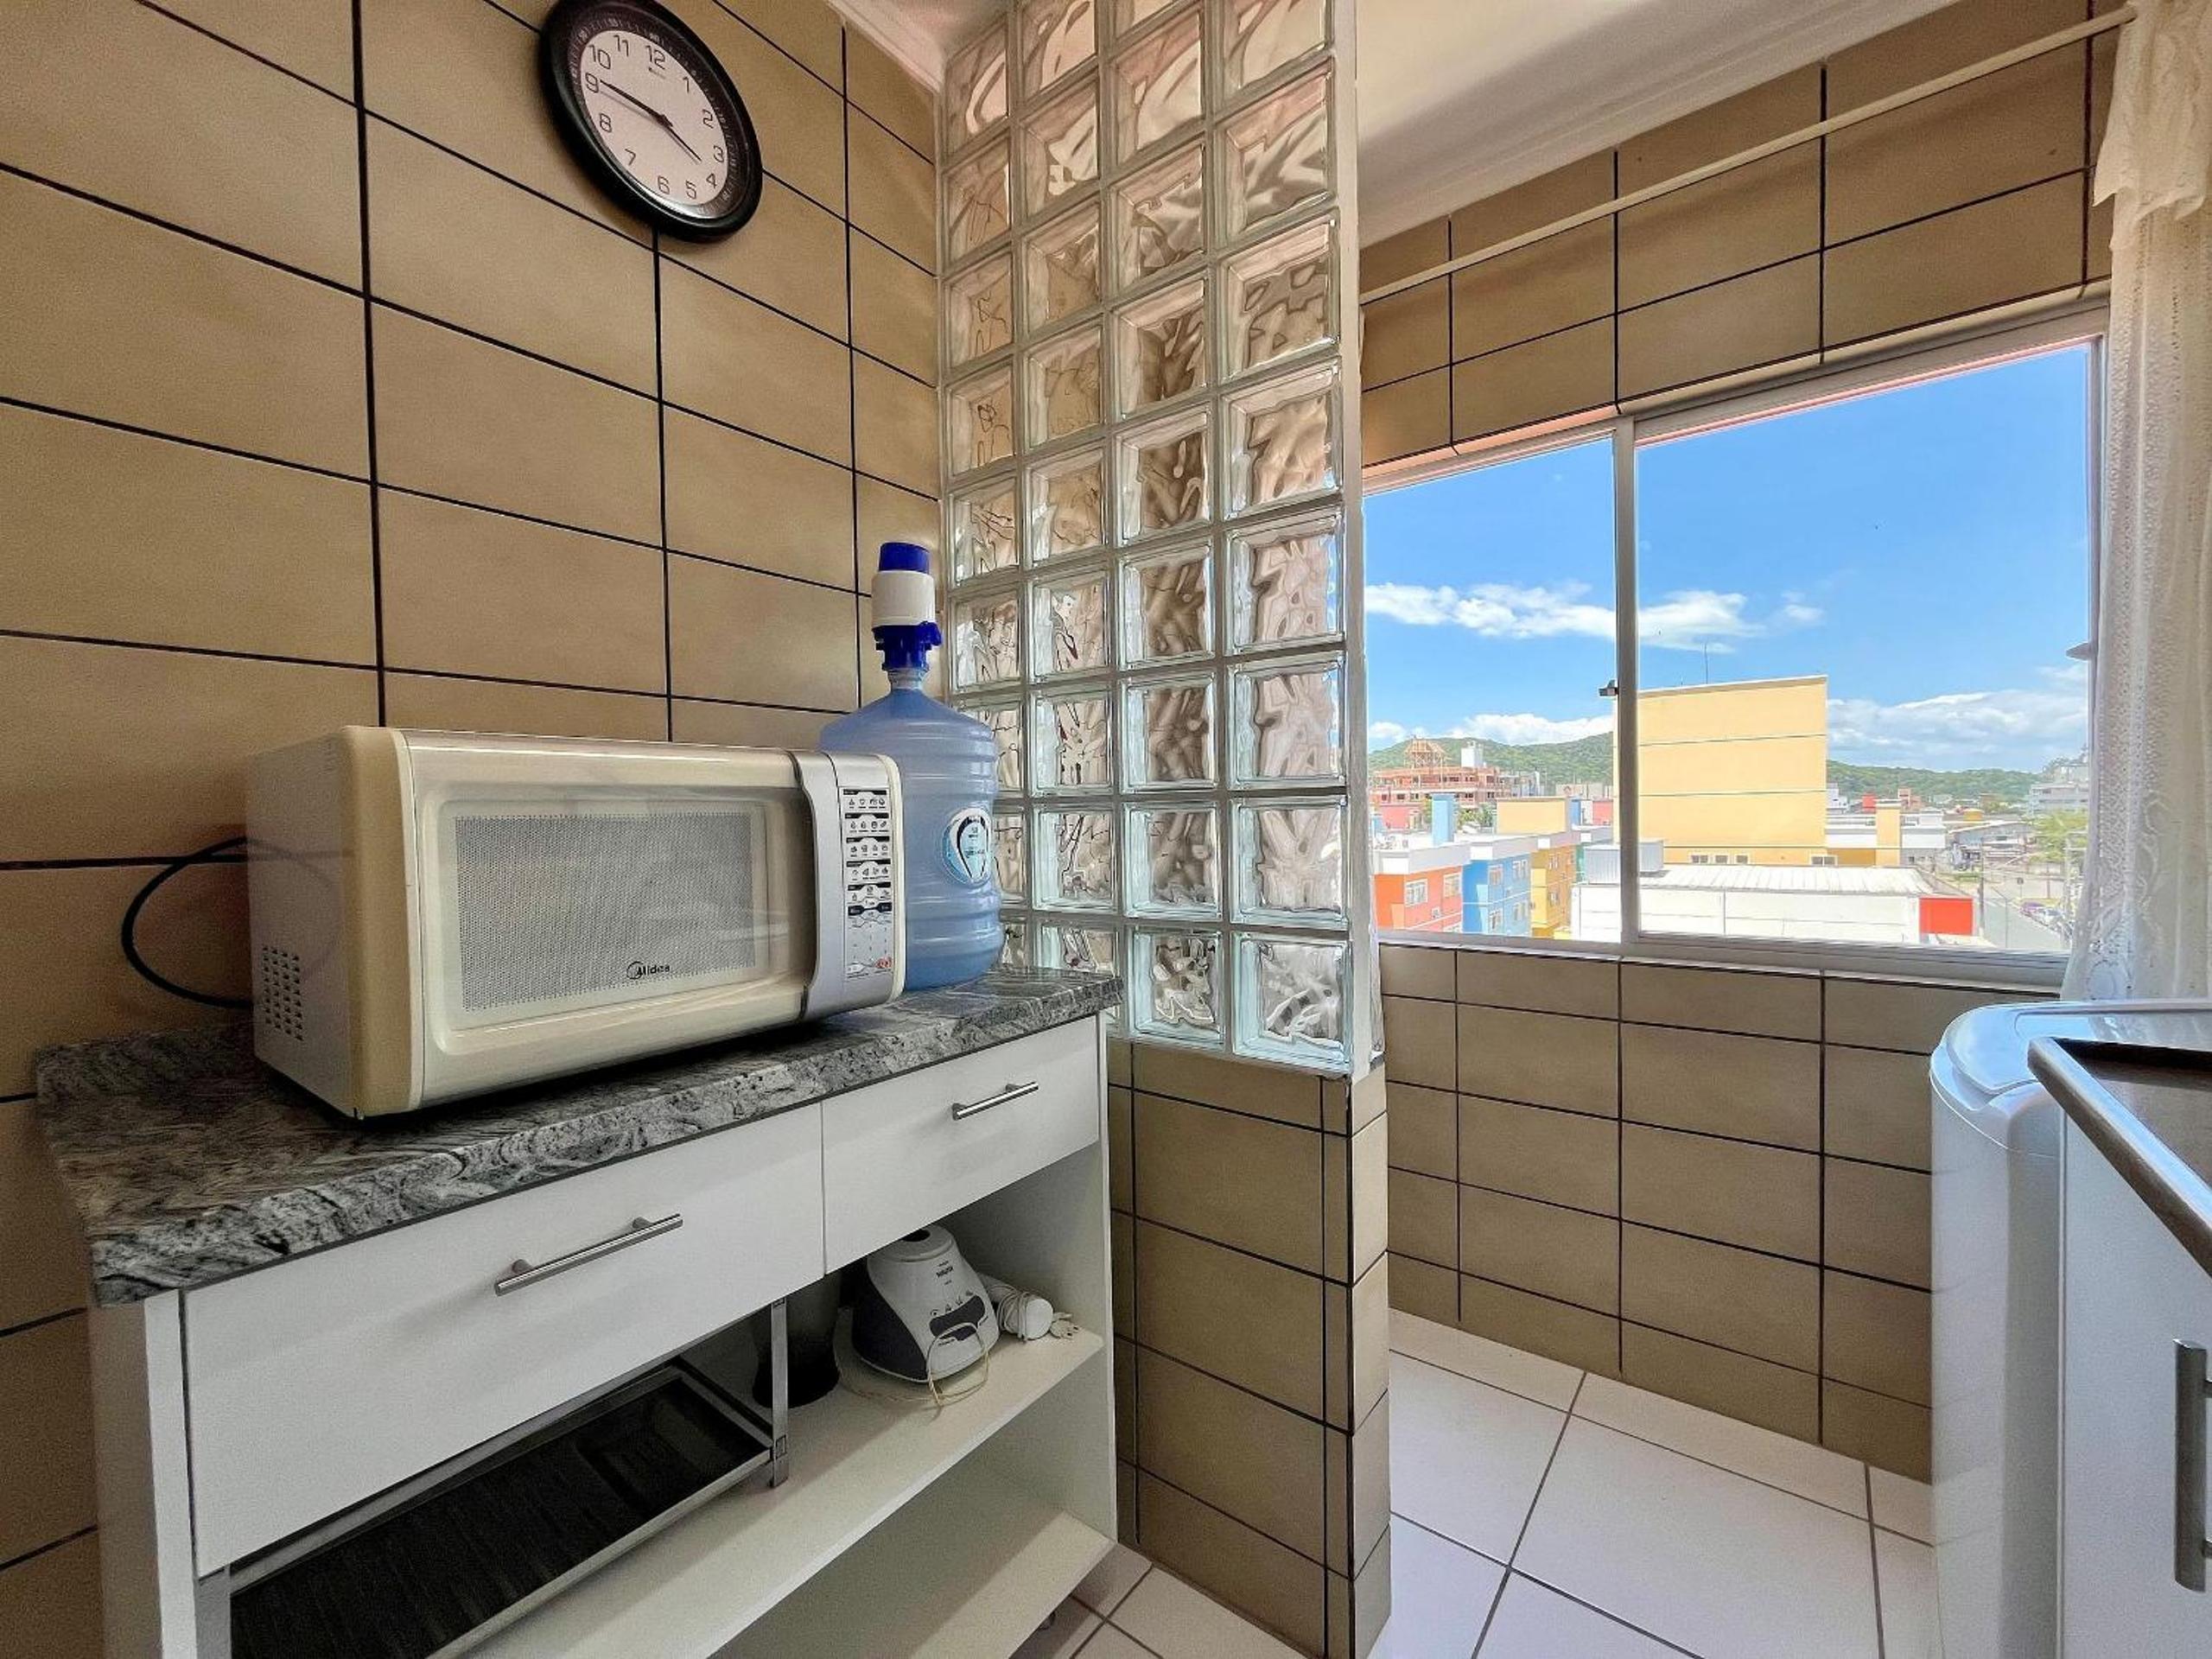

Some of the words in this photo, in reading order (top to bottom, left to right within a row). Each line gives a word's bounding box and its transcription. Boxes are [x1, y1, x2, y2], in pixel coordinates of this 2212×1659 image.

[613, 35, 629, 57] 11
[588, 44, 611, 69] 10
[645, 45, 665, 70] 12
[585, 73, 599, 93] 9
[683, 76, 690, 93] 1
[600, 112, 612, 133] 8
[702, 109, 714, 129] 2
[625, 148, 636, 166] 7
[713, 145, 724, 163] 3
[658, 175, 670, 194] 6
[685, 180, 696, 200] 5
[706, 173, 717, 188] 4
